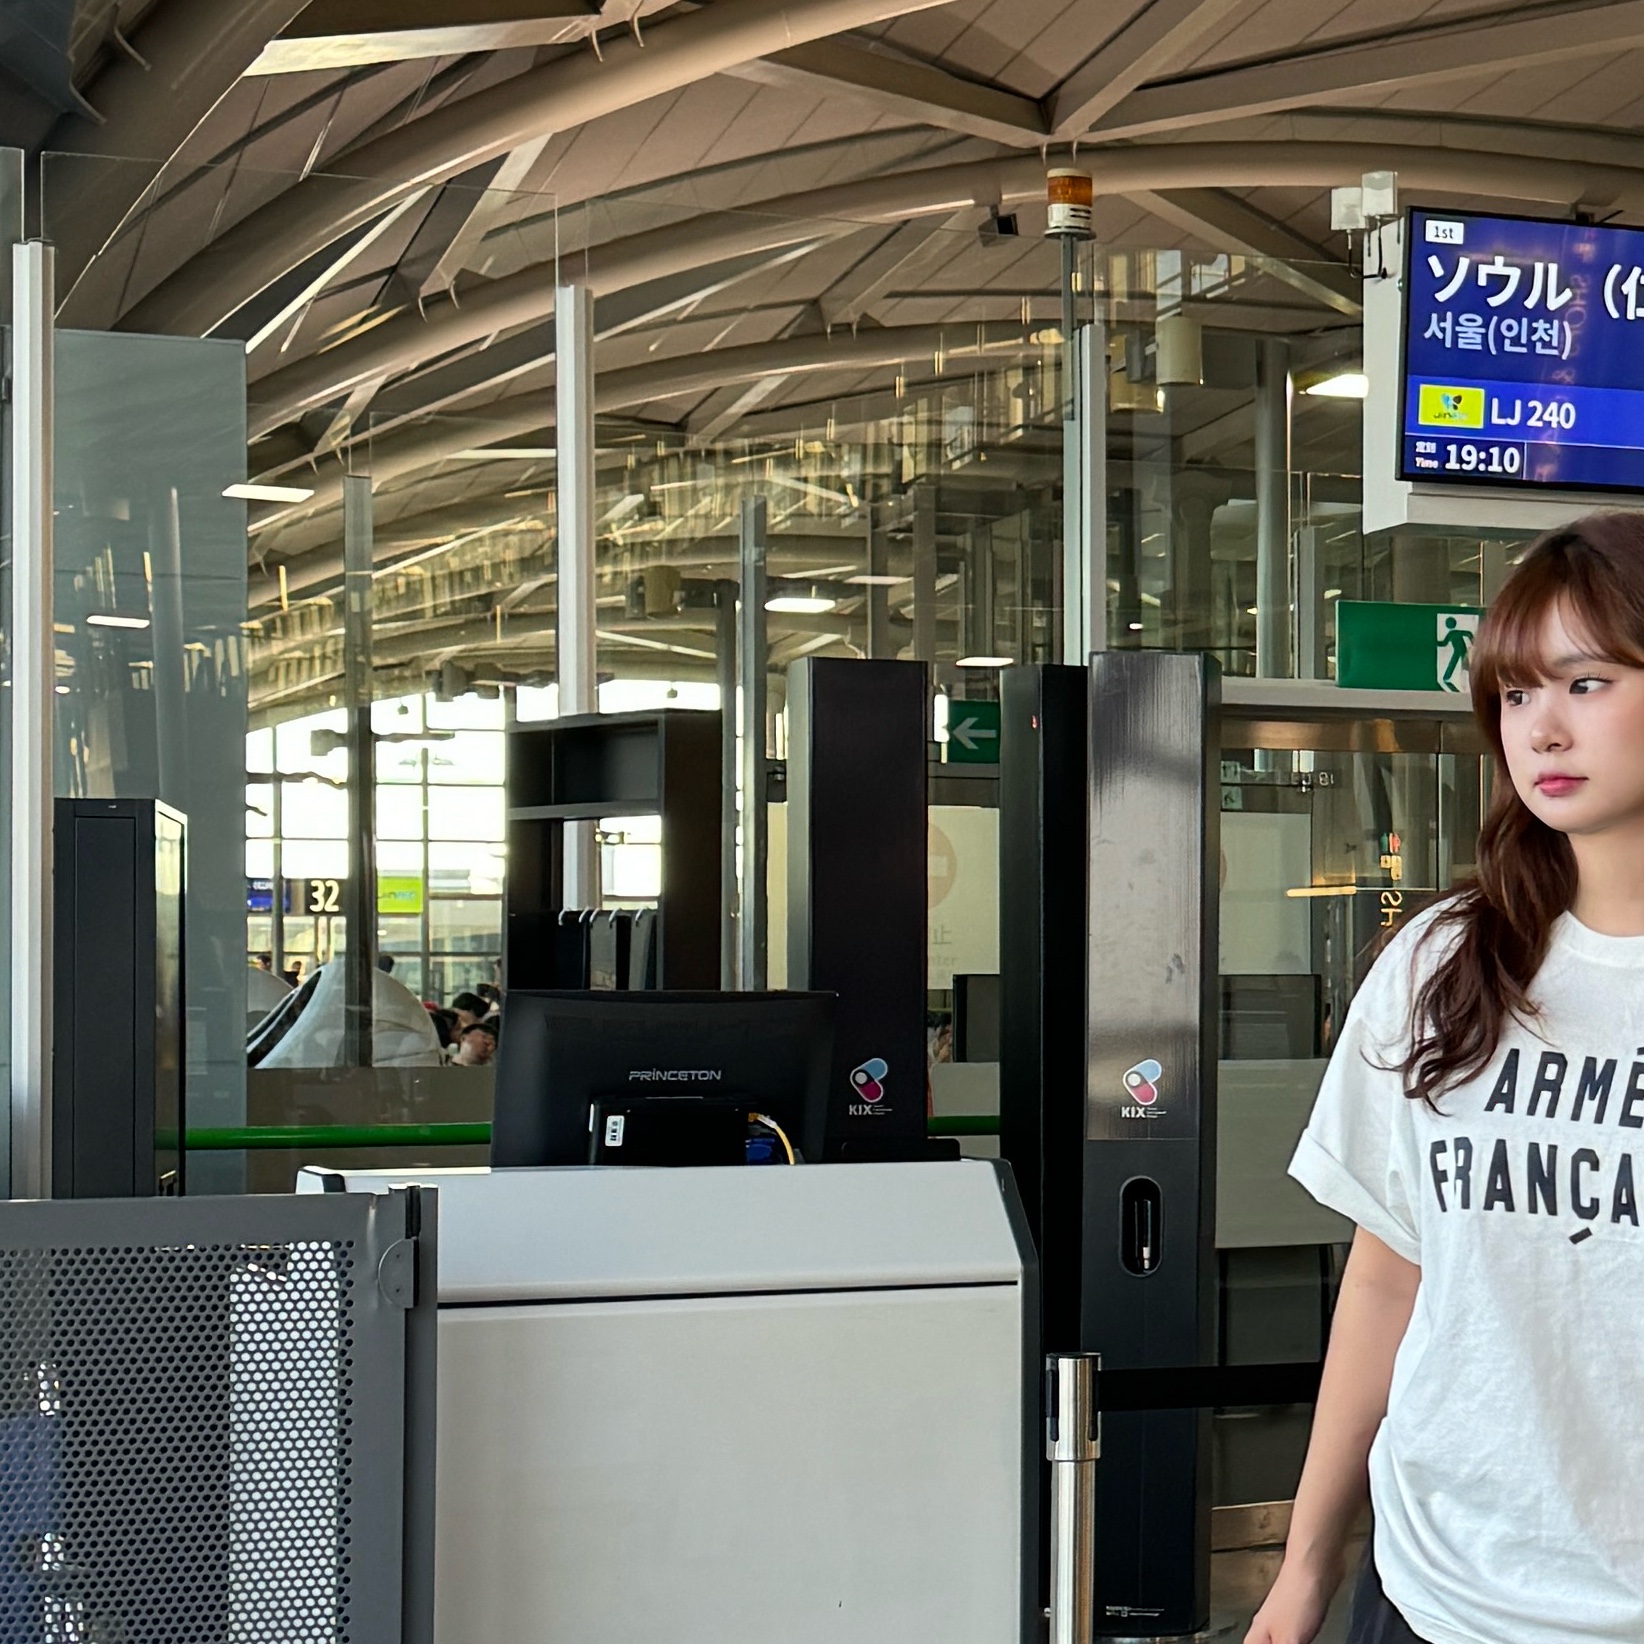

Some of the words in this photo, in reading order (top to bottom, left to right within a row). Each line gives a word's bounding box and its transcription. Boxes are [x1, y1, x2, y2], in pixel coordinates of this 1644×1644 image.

[1433, 224, 1454, 240] 1st
[1423, 311, 1572, 360] 서울(인천)
[1491, 397, 1522, 426] LJ
[1526, 399, 1577, 429] 240
[1445, 444, 1521, 474] 19:10
[309, 879, 340, 913] 32
[627, 1067, 722, 1081] PRINCETON
[848, 1103, 873, 1116] KIX
[1121, 1105, 1146, 1118] KIX
